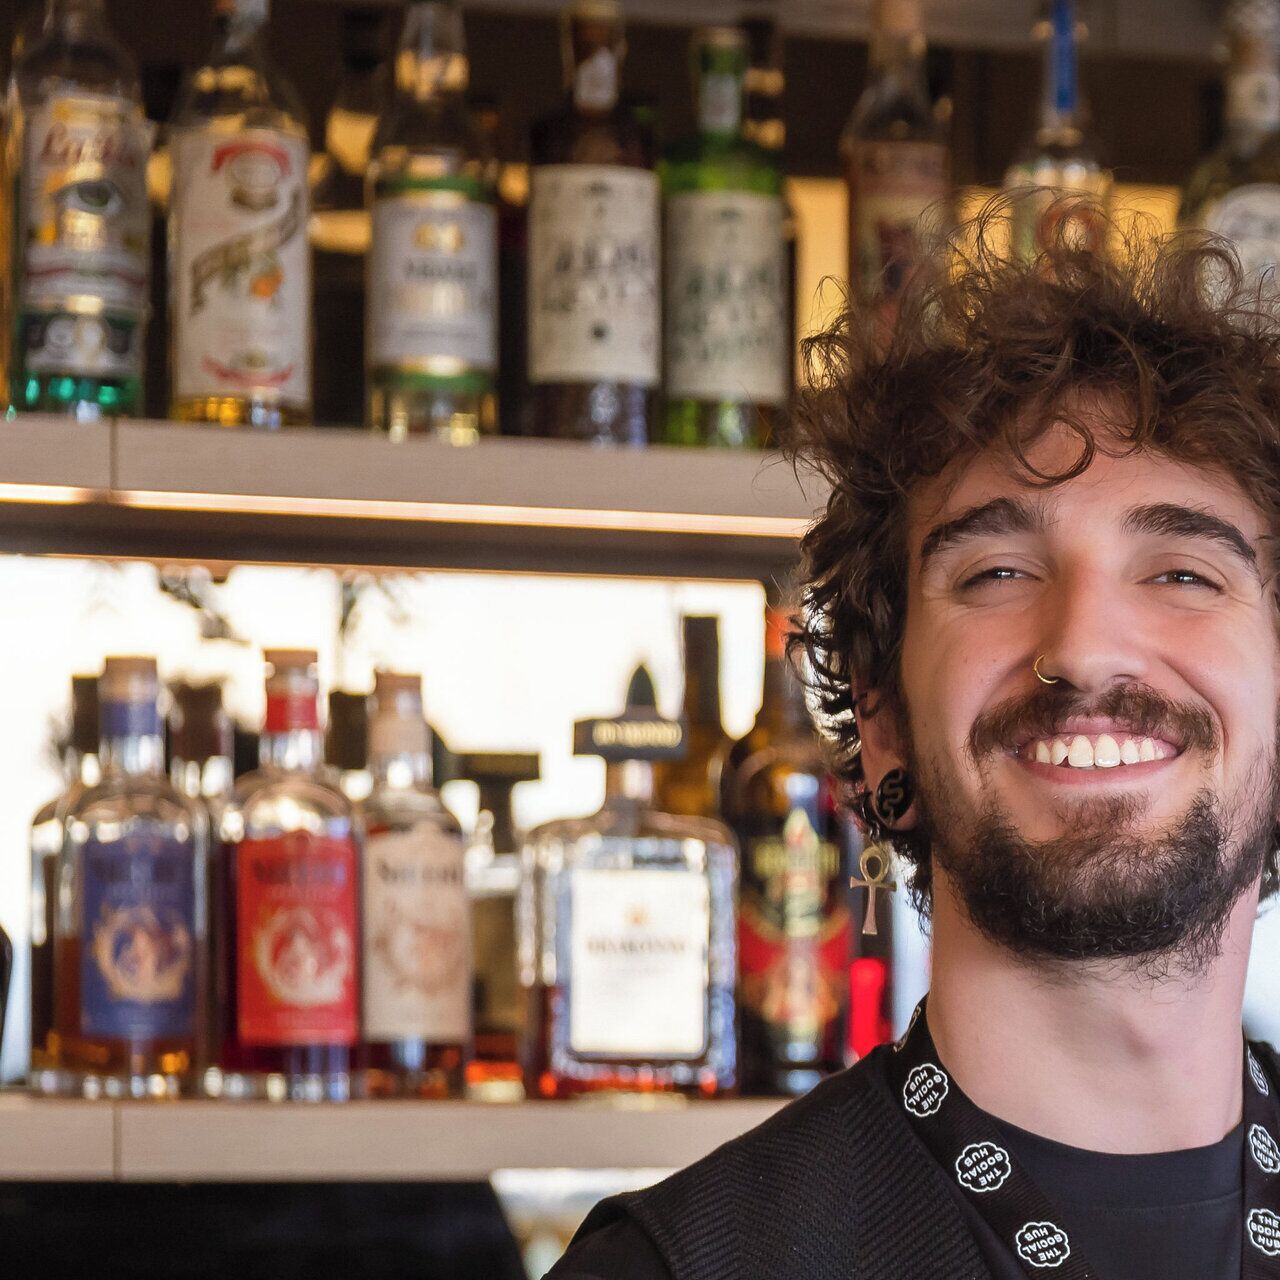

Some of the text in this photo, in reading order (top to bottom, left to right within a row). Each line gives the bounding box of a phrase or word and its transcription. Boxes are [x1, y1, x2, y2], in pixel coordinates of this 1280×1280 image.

[908, 1074, 942, 1106] SOCIAL
[910, 1070, 928, 1091] HUB
[921, 1090, 939, 1110] THE
[963, 1152, 1003, 1180] SOCIAL
[964, 1147, 989, 1167] HUB
[979, 1167, 1002, 1186] THE
[1258, 1215, 1279, 1228] THE
[1022, 1234, 1063, 1254] SOCIAL
[1024, 1227, 1049, 1241] HUB
[1258, 1235, 1280, 1248] HUB
[1038, 1247, 1061, 1261] THE
